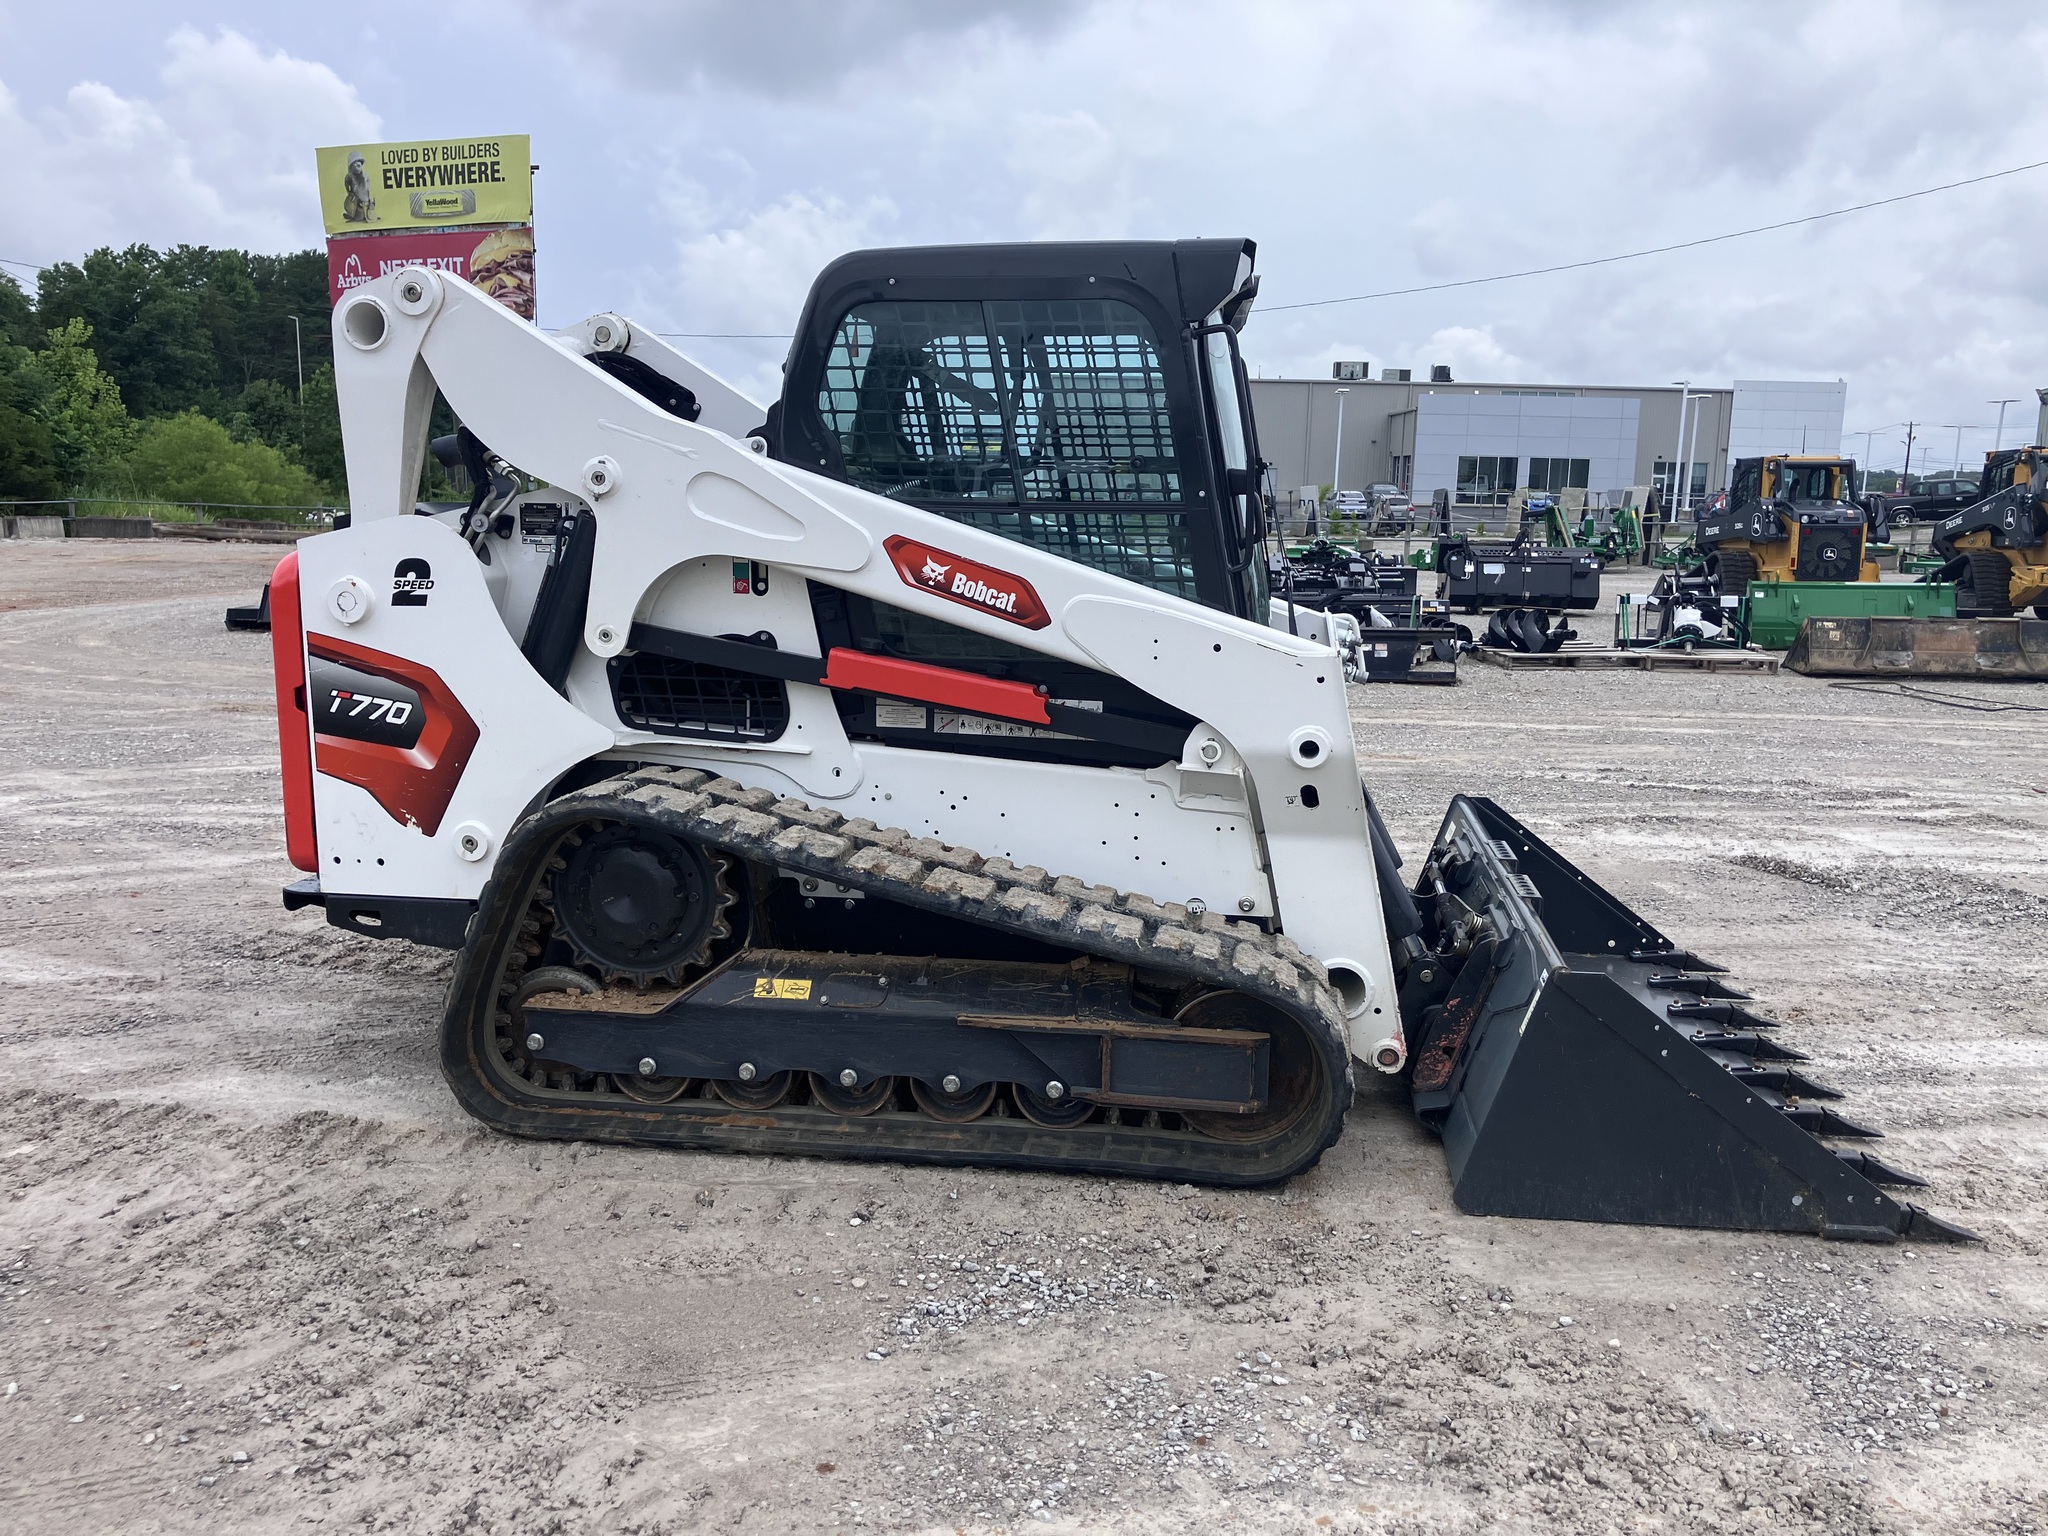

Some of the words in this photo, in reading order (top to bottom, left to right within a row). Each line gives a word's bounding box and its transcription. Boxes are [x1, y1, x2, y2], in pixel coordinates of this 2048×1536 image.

[381, 148, 418, 165] LOVED
[423, 147, 438, 162] BY
[442, 142, 500, 161] BUILDERS
[382, 161, 505, 190] EVERYWHERE.
[425, 197, 458, 206] YellaWood
[1705, 526, 1720, 536] DEERE
[1946, 516, 1963, 530] DEERE
[391, 557, 431, 606] 2
[393, 579, 434, 590] SPEED
[951, 572, 1017, 613] Bobcat
[329, 689, 414, 725] T770
